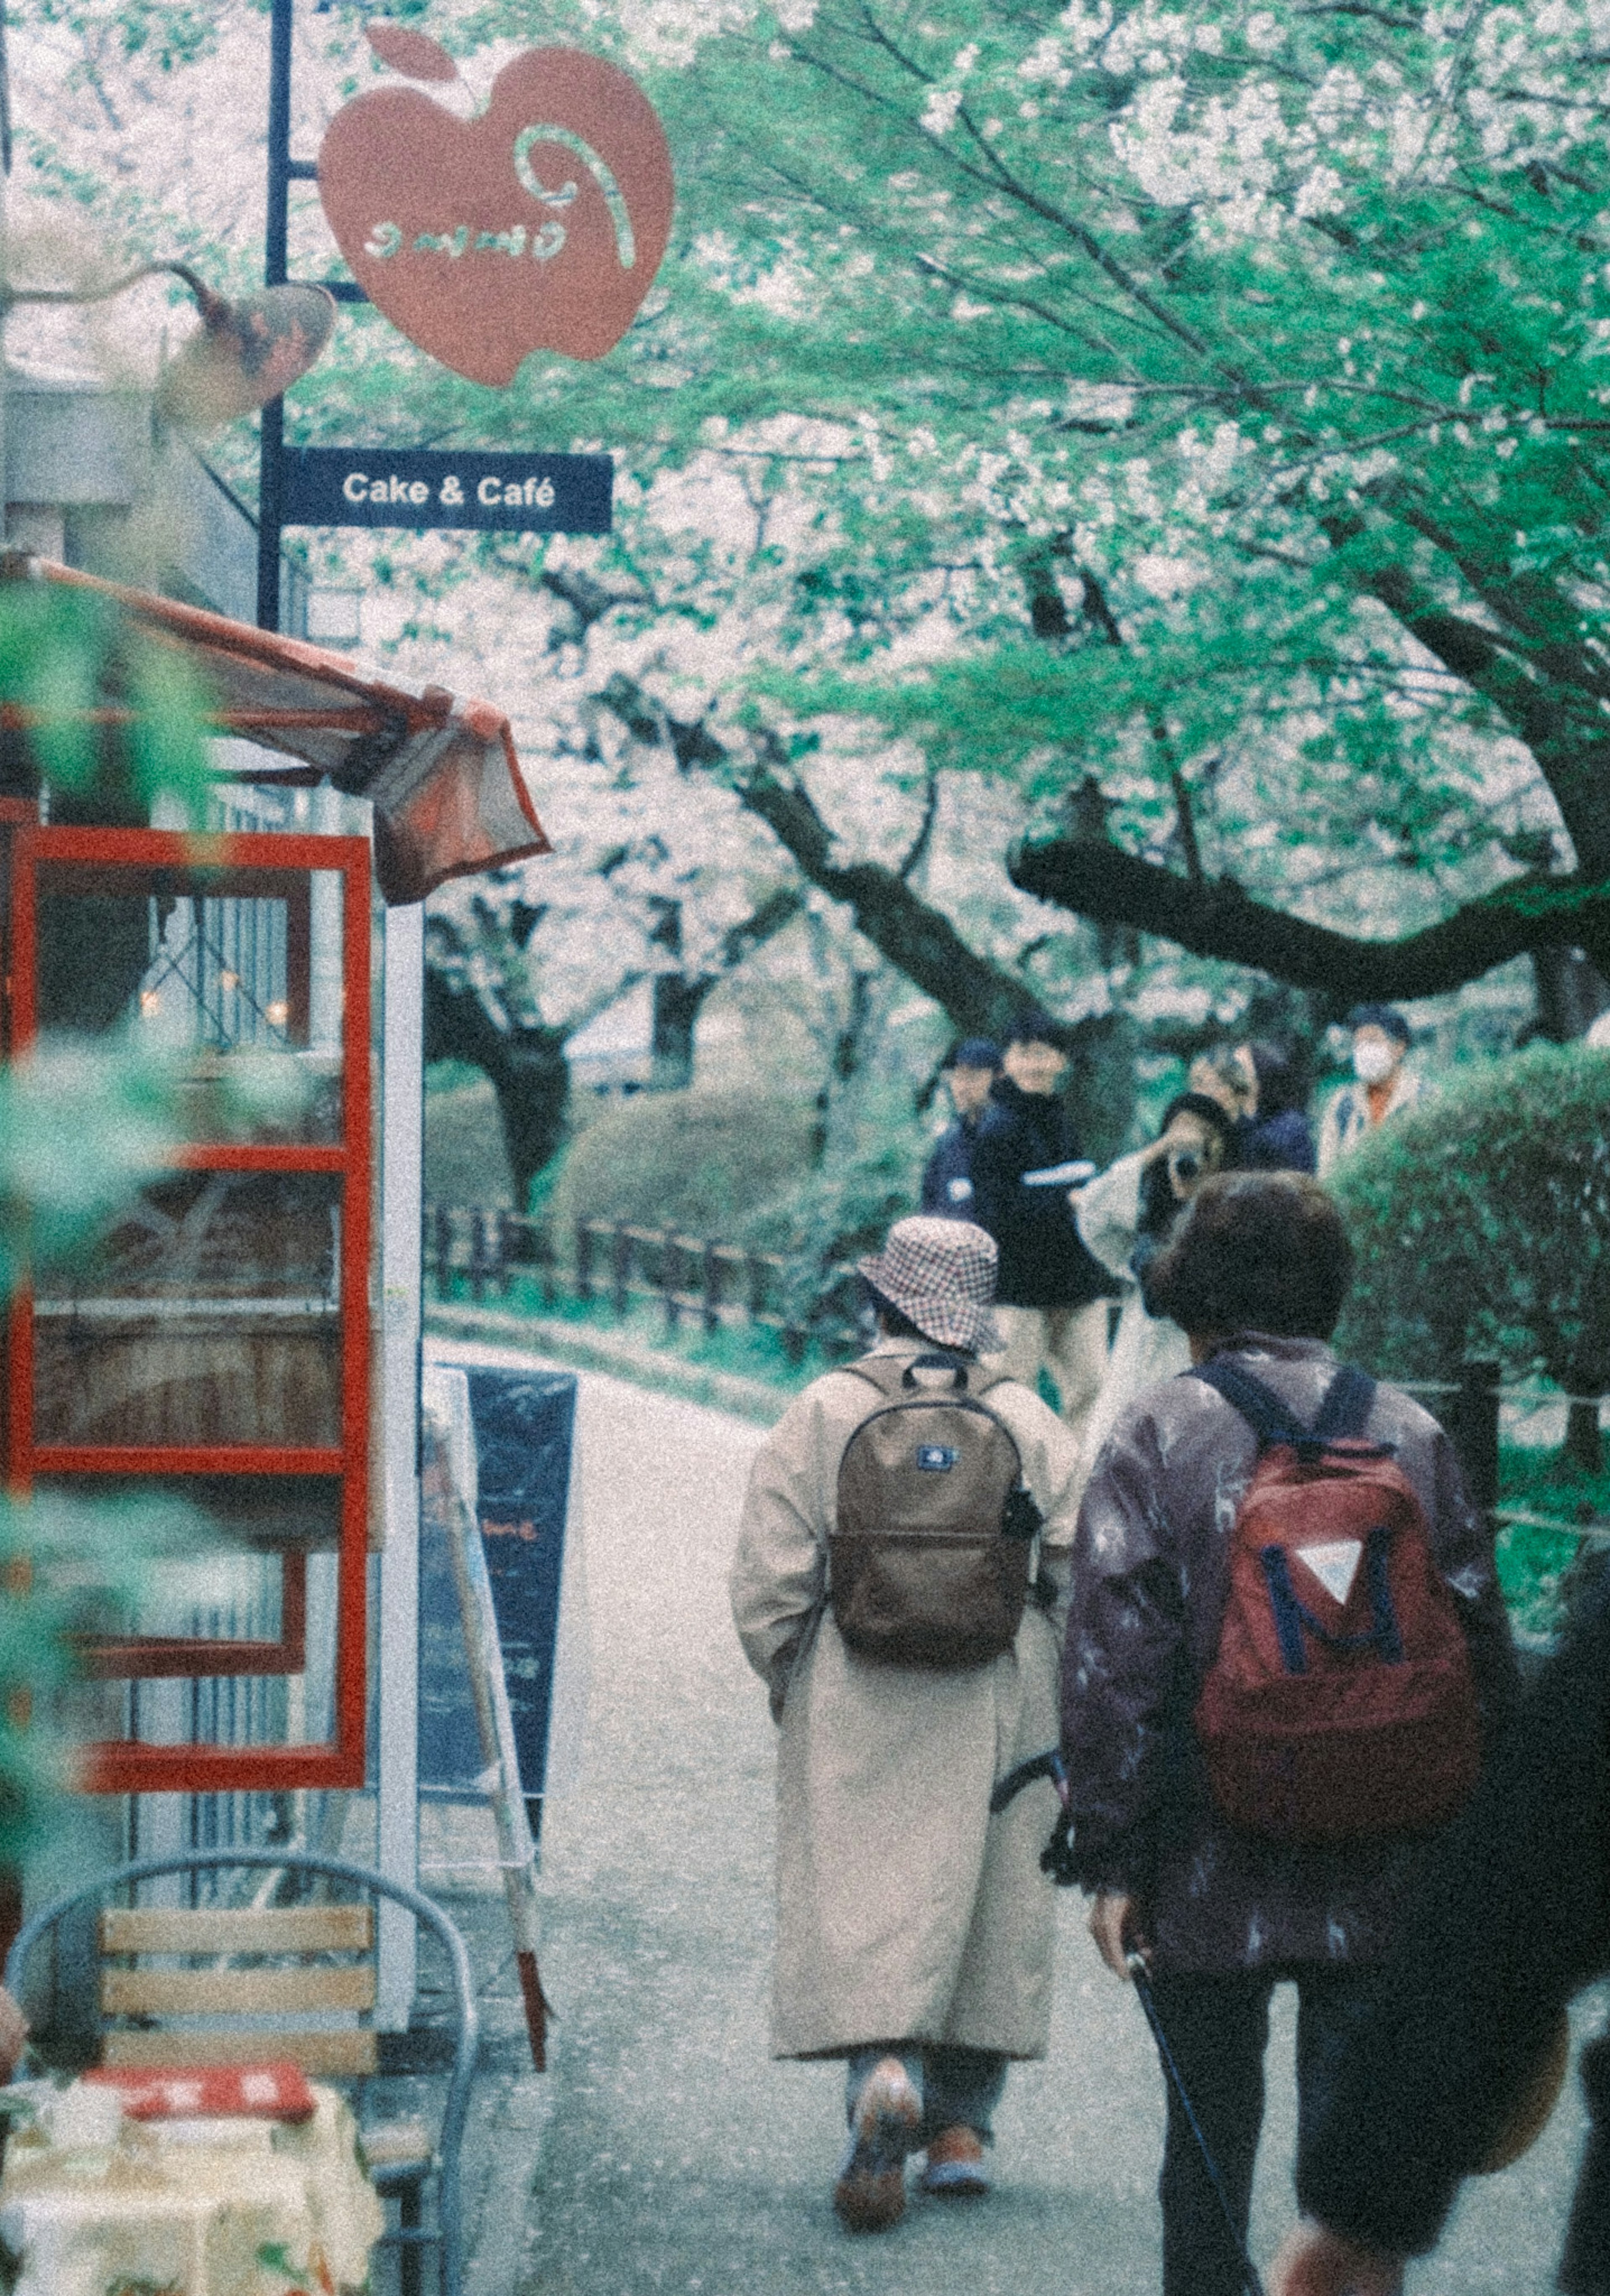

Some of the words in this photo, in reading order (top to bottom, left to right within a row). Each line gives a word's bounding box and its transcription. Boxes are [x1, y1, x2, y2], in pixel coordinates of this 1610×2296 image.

[343, 472, 429, 503] Cake
[439, 475, 464, 504] &
[477, 476, 555, 507] Café
